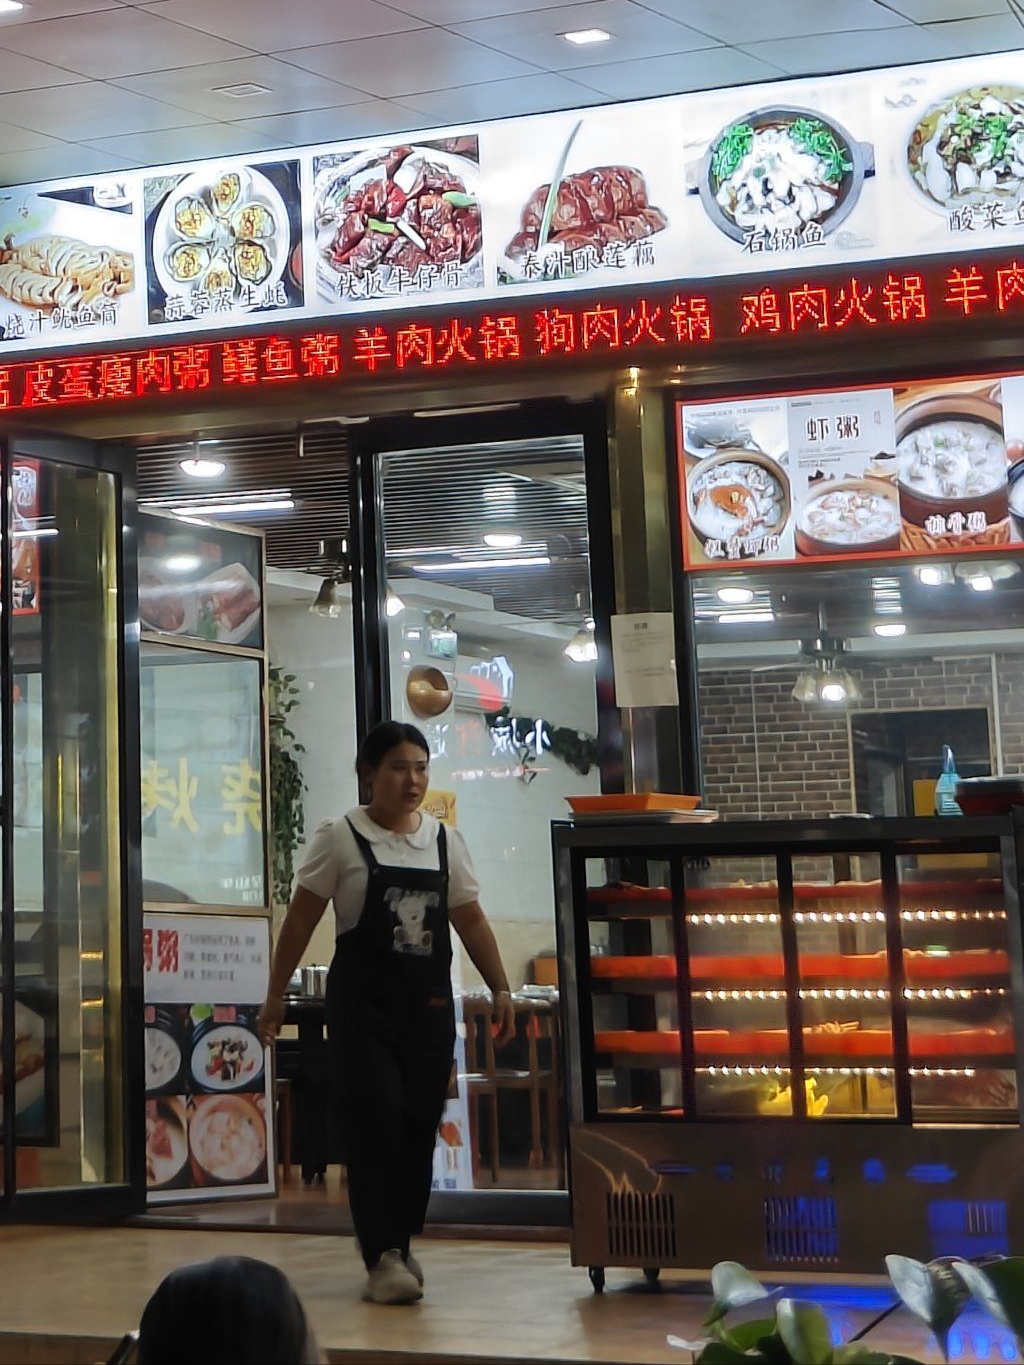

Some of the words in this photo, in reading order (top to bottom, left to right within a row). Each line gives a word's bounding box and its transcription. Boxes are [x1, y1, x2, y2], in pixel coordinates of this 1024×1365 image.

[743, 222, 827, 256] 石锅鱼
[337, 260, 464, 298] 铁板牛仔骨
[353, 313, 521, 373] 羊肉火锅
[535, 293, 712, 357] 狗肉火锅
[740, 274, 927, 336] 鸡肉火锅
[806, 413, 860, 442] 虾粥
